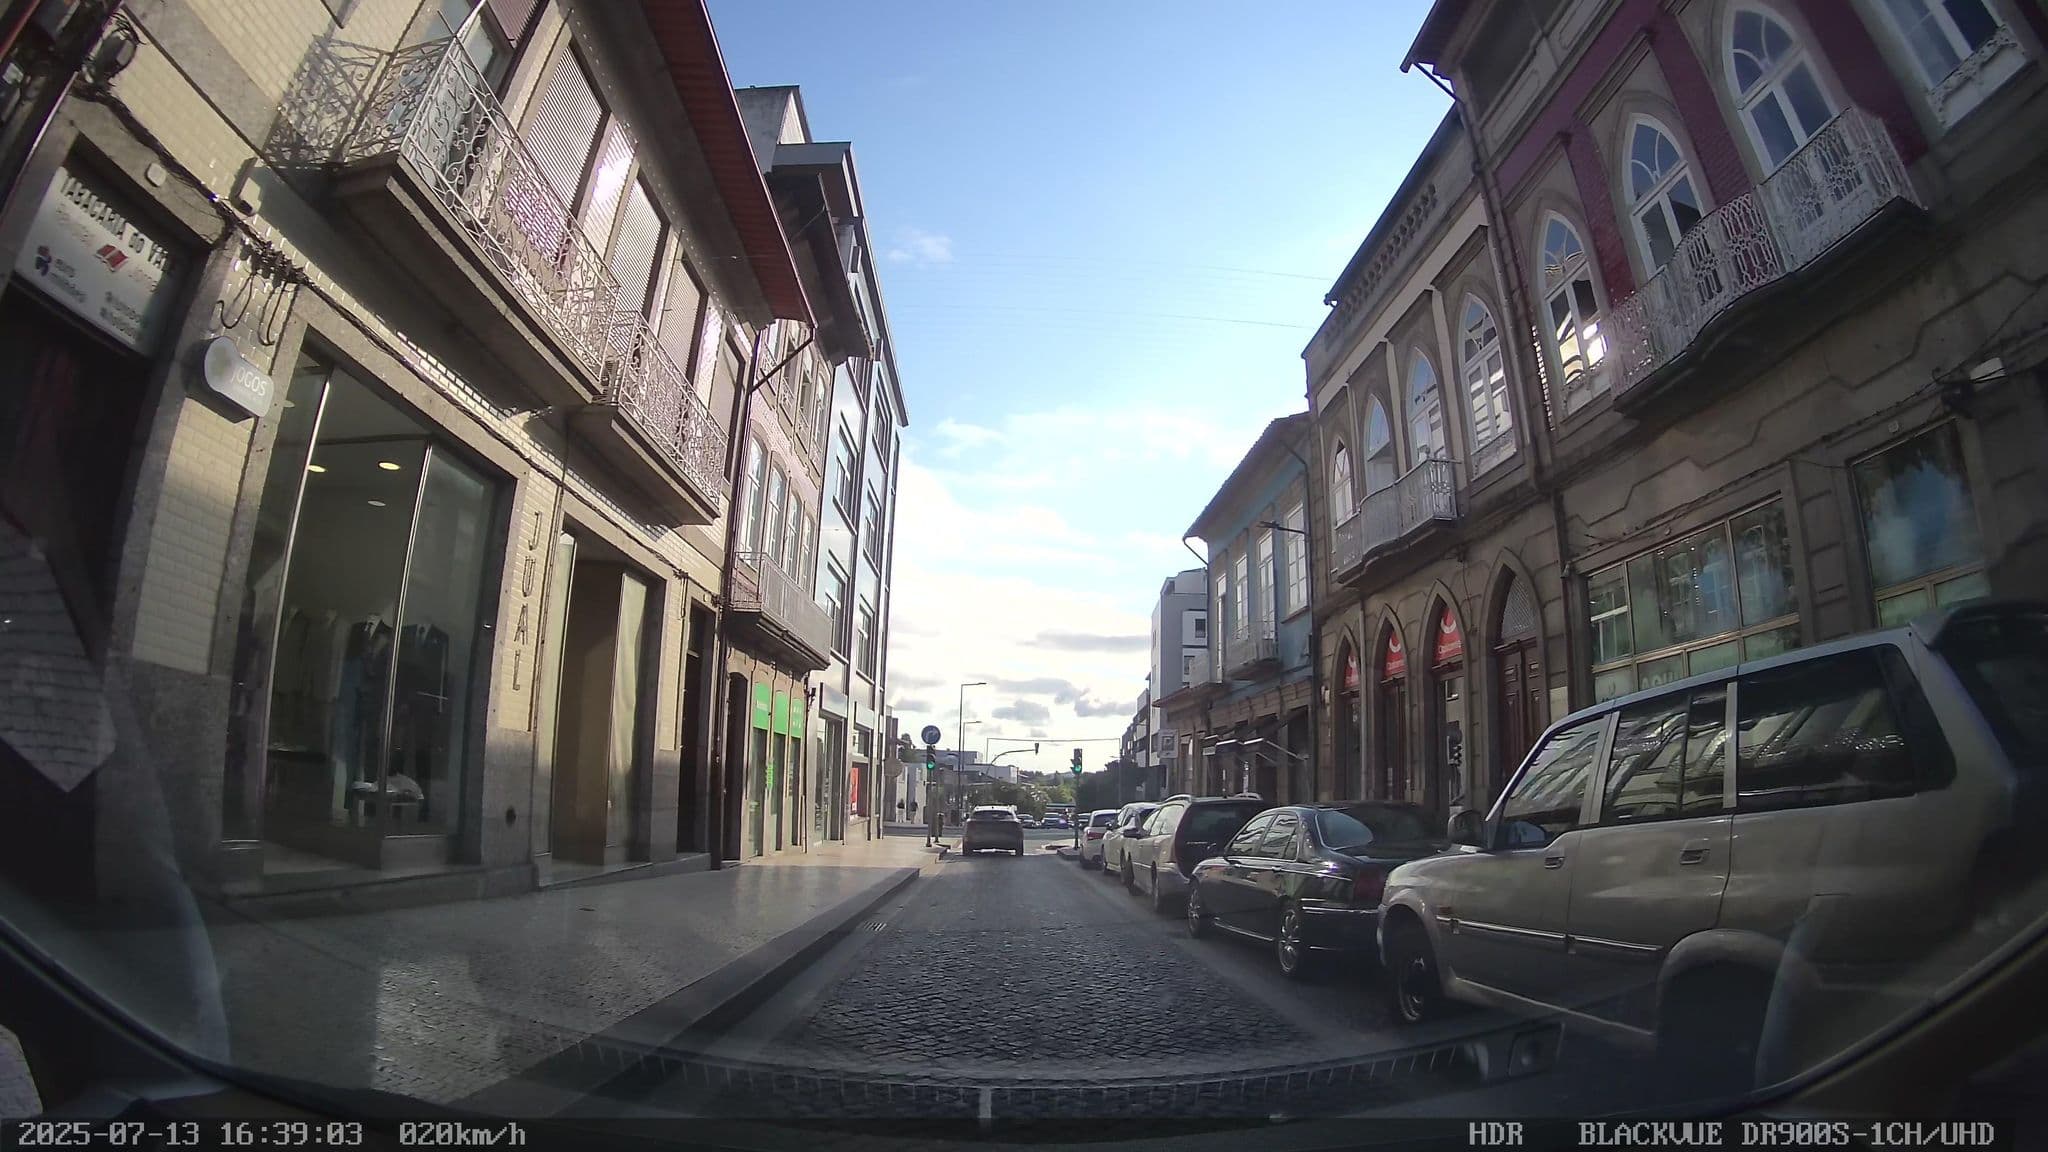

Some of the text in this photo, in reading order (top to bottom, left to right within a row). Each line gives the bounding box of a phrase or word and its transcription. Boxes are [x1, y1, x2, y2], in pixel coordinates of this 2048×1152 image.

[61, 176, 126, 241] TABACARIA
[128, 231, 145, 254] DO
[512, 510, 542, 691] JUAL
